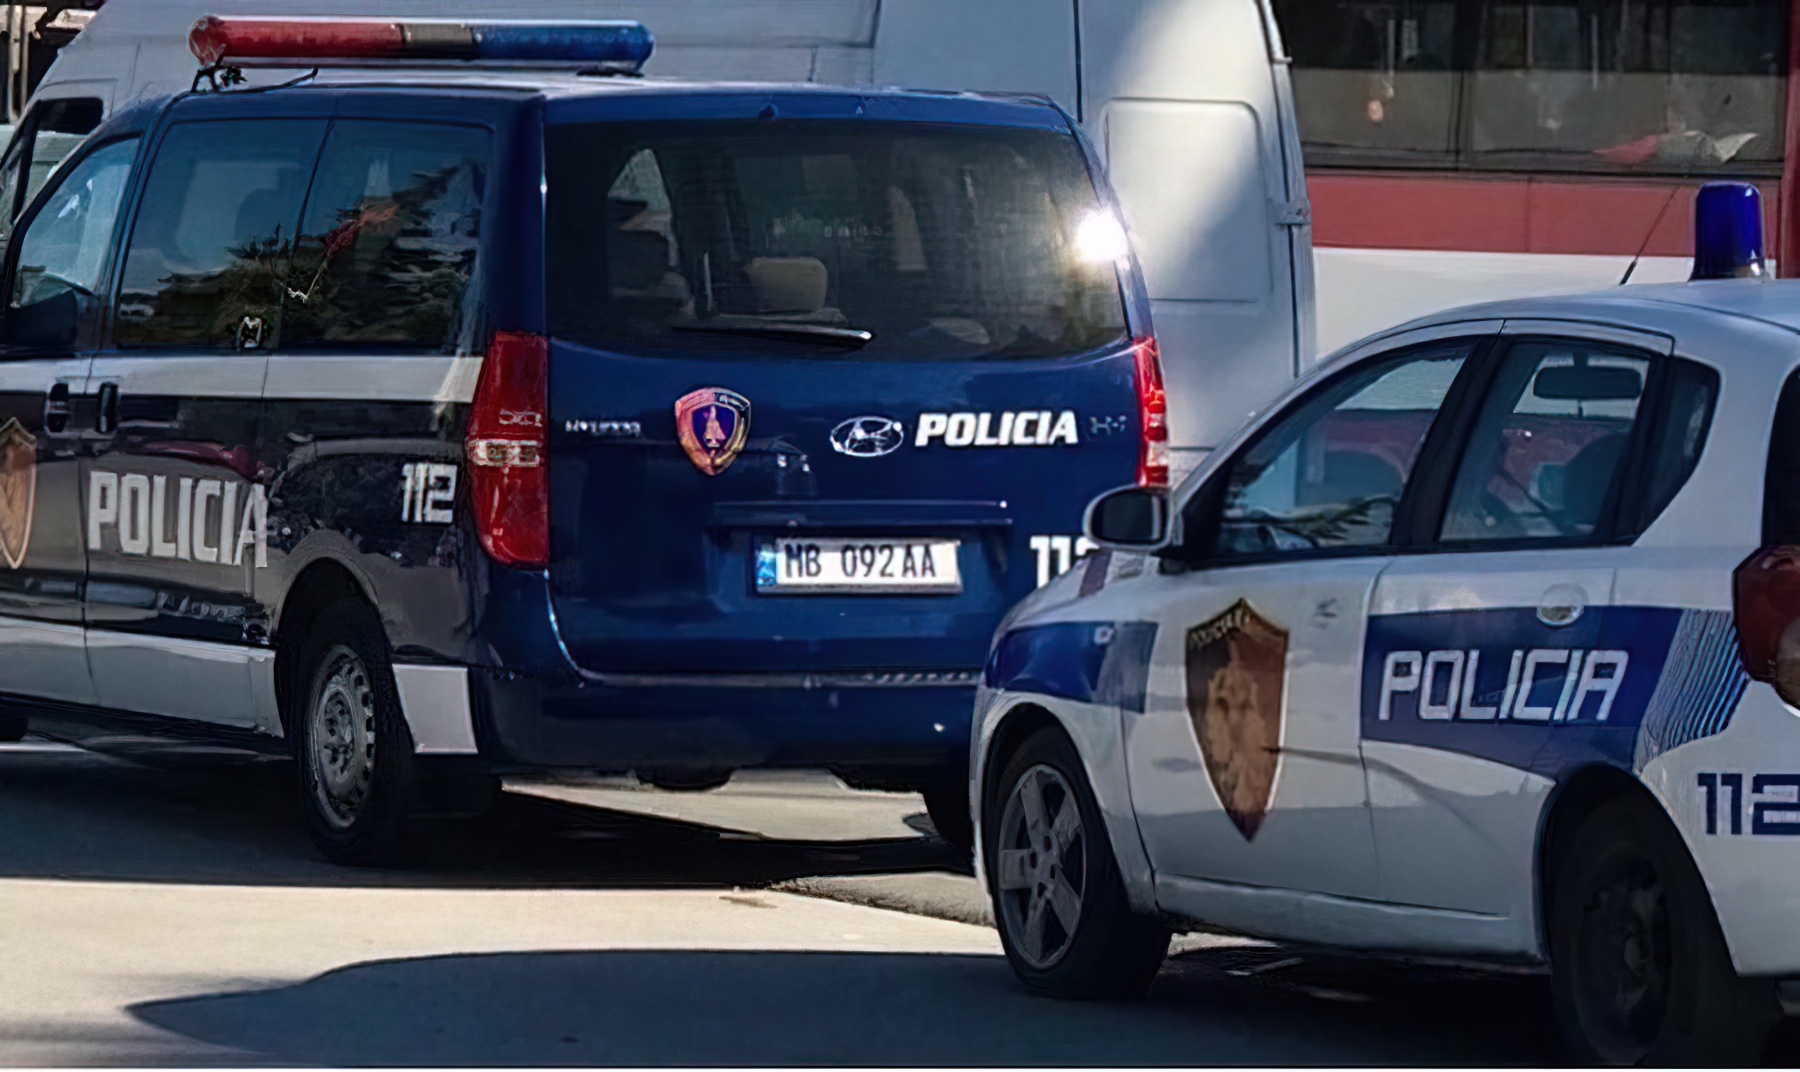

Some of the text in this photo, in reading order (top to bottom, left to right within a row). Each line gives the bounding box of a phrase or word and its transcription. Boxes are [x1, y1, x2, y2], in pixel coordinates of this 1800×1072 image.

[915, 410, 1079, 447] POLICIA
[88, 471, 267, 568] POLICIA
[401, 463, 457, 523] 112
[1030, 535, 1100, 589] 11
[1379, 649, 1629, 721] POLICIA
[1697, 773, 1800, 835] 112
